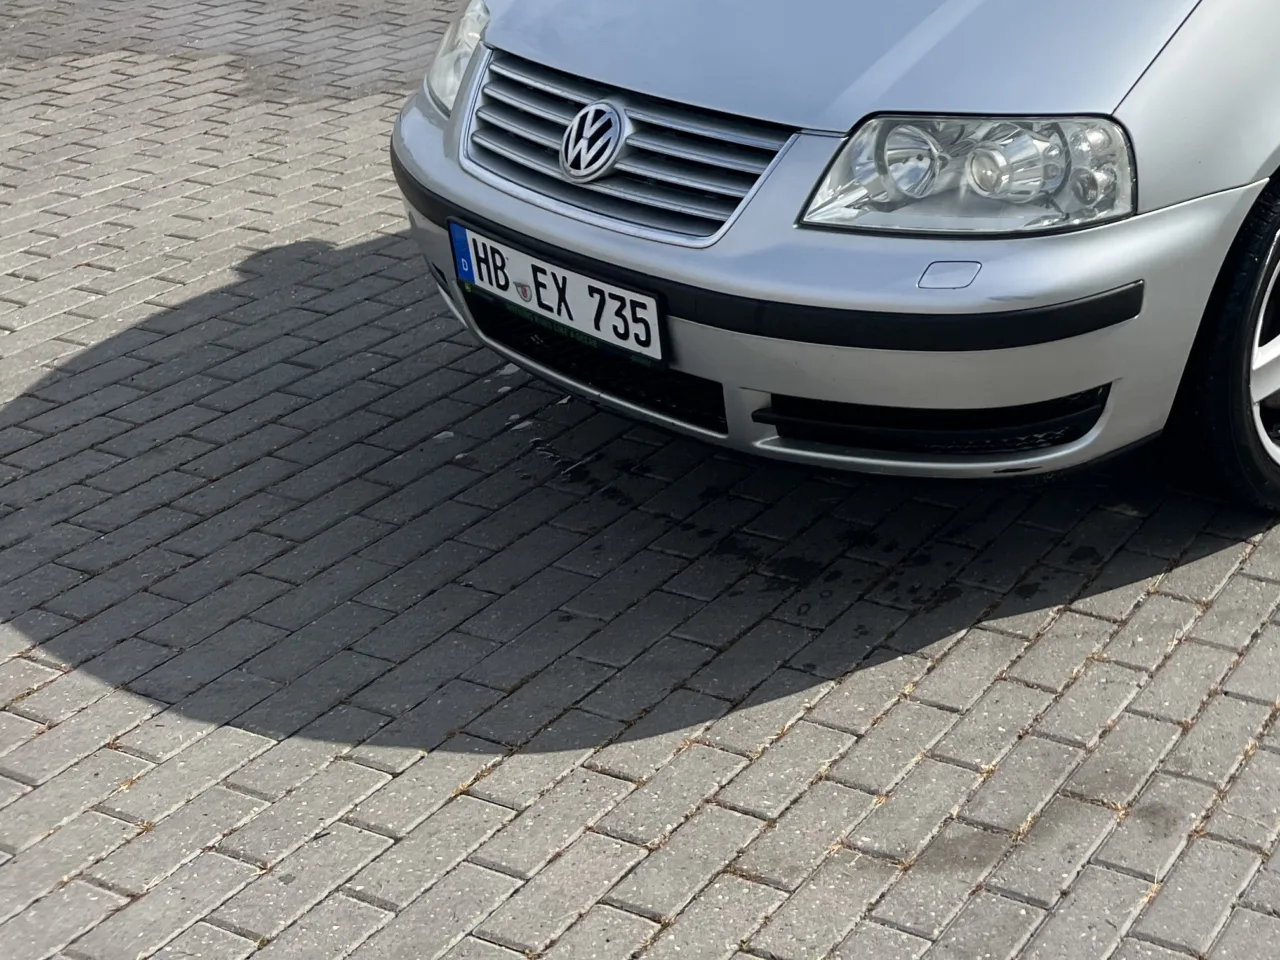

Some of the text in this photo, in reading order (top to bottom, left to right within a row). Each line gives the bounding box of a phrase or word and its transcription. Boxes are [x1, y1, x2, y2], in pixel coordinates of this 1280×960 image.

[461, 258, 469, 272] D
[471, 237, 510, 291] HB
[530, 263, 574, 321] EX
[587, 284, 651, 348] 735
